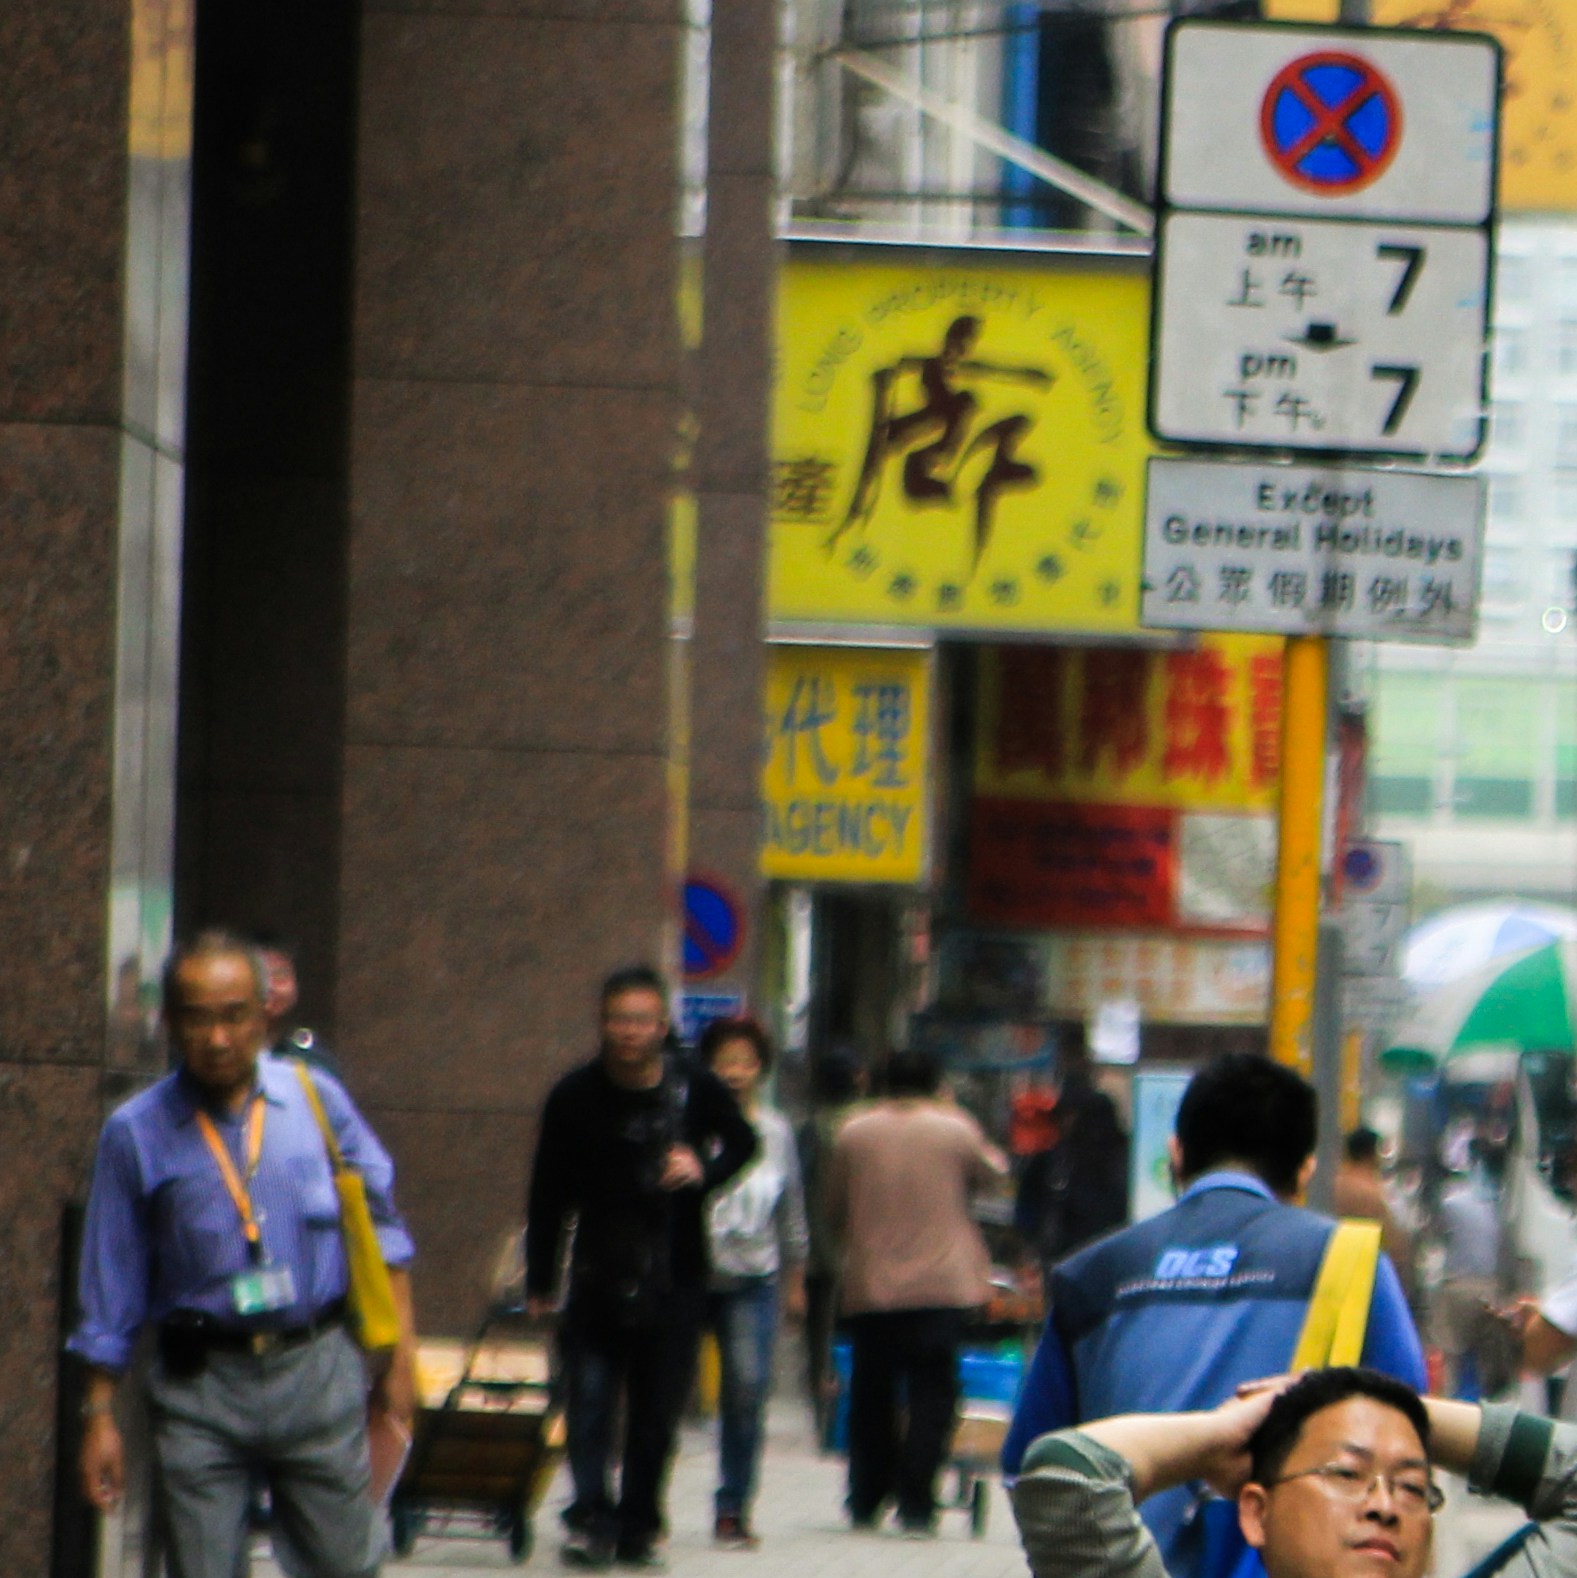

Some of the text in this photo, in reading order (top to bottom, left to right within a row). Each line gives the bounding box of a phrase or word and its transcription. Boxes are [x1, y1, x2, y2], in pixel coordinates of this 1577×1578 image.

[1247, 230, 1302, 258] am
[1226, 269, 1318, 312] 上午
[1376, 242, 1426, 316] 7
[1239, 353, 1297, 386] pm
[1222, 388, 1312, 432] 下午
[1370, 361, 1420, 436] 7
[1256, 481, 1374, 518] Except
[1163, 514, 1463, 565] General Holidays
[1164, 563, 1457, 616] 公眾假期例外
